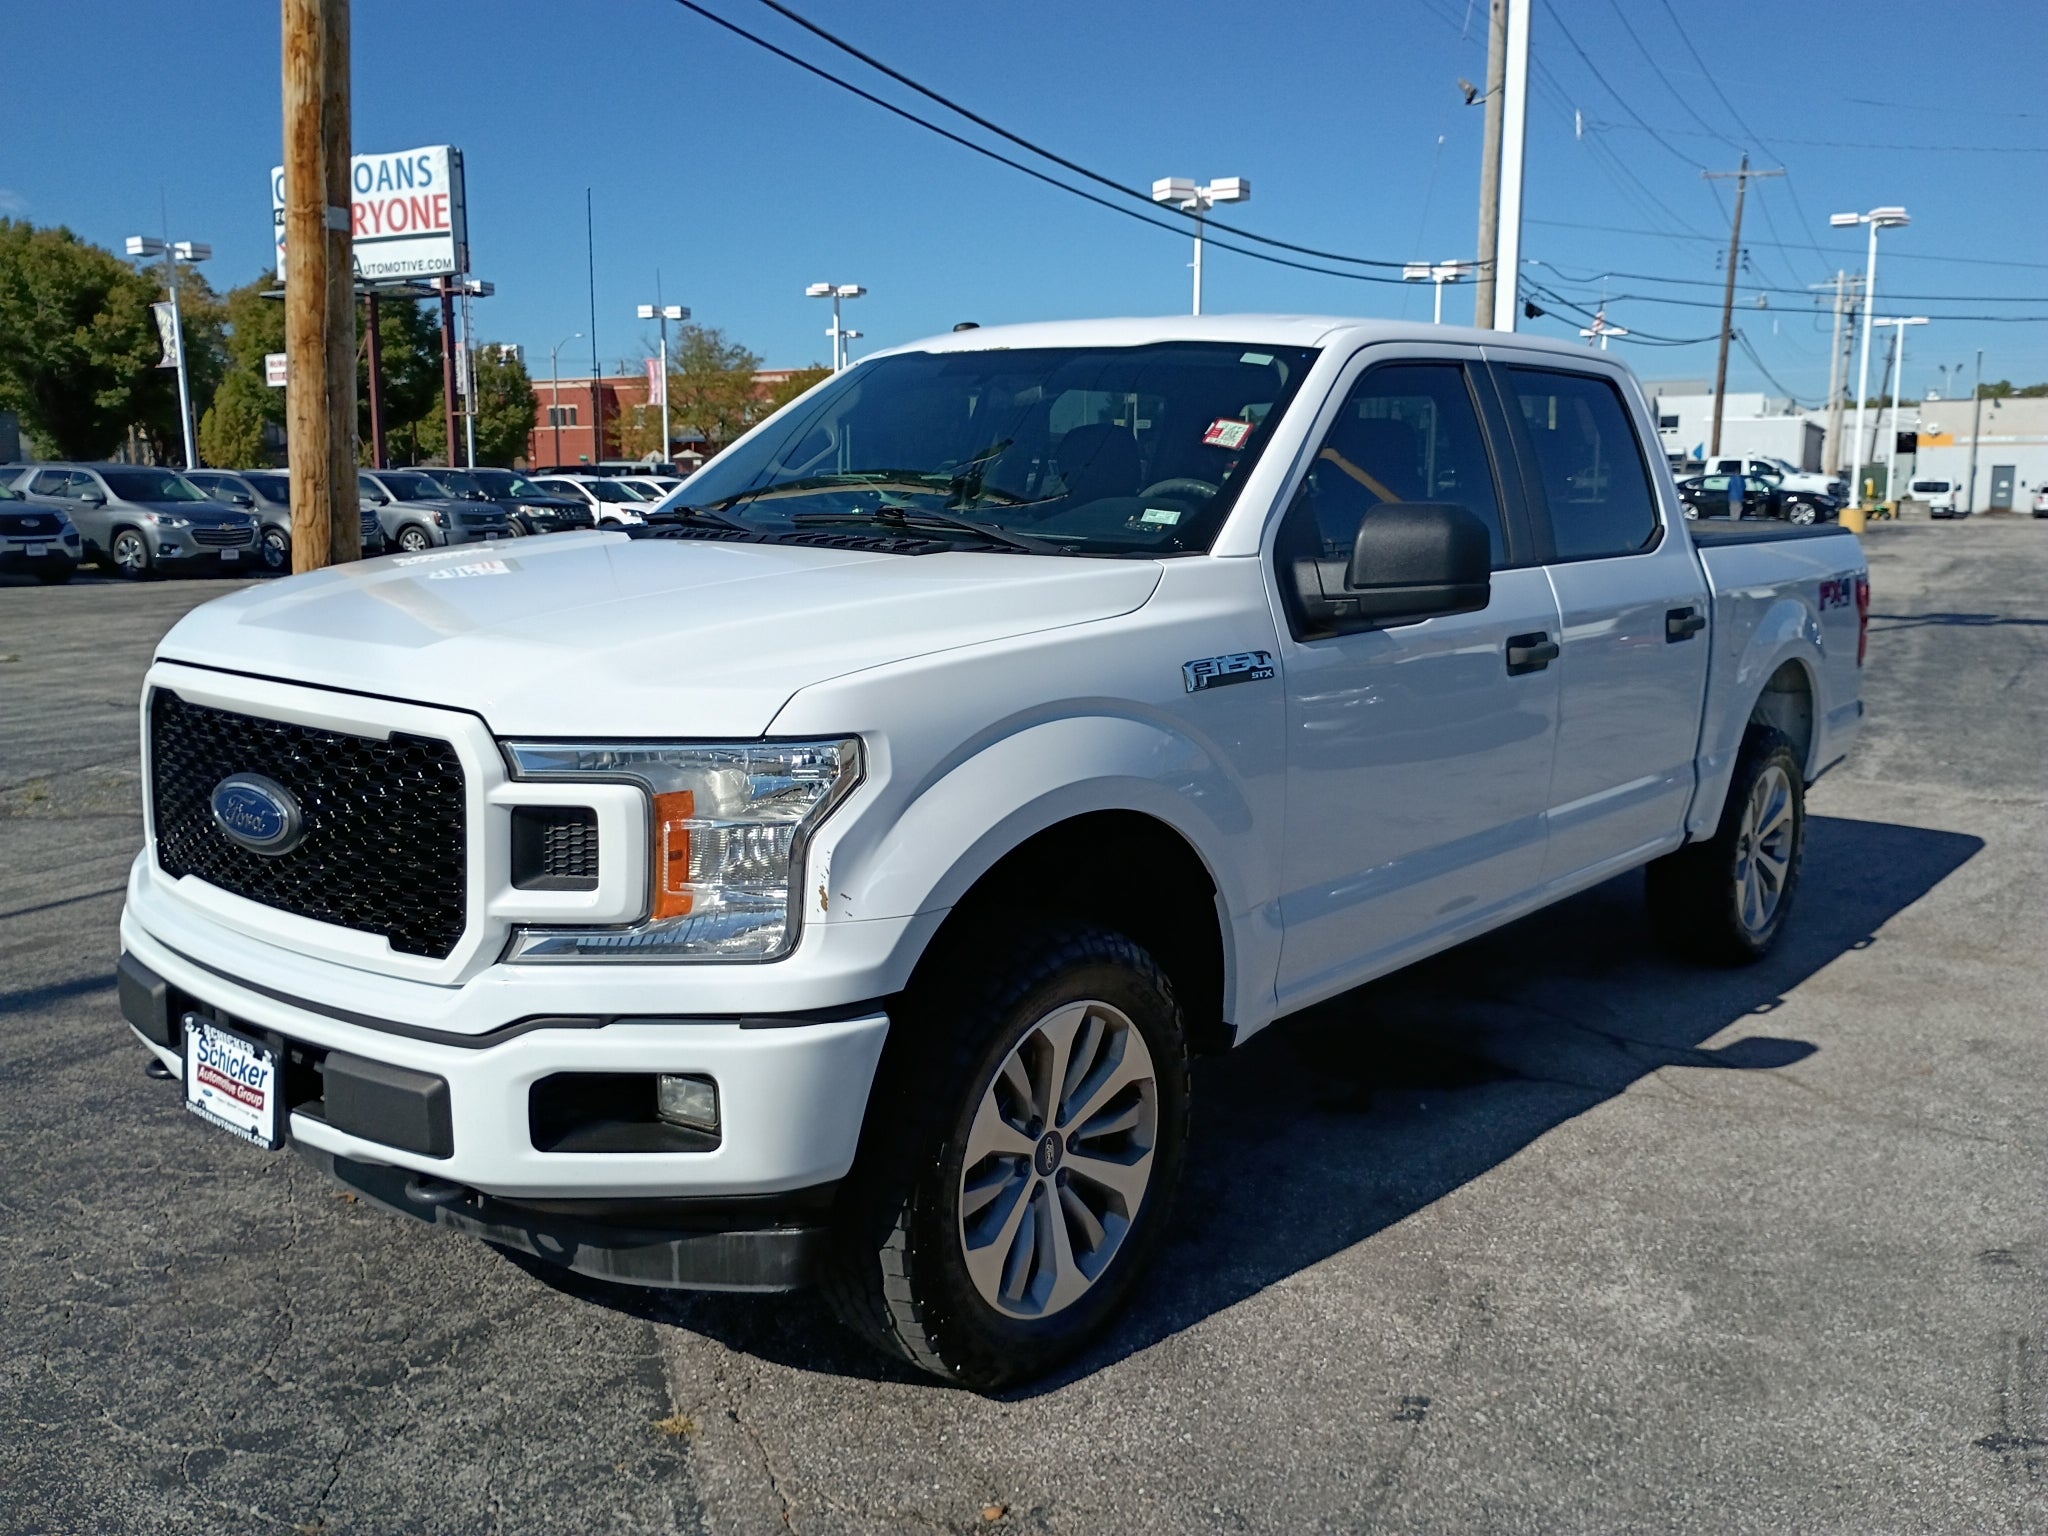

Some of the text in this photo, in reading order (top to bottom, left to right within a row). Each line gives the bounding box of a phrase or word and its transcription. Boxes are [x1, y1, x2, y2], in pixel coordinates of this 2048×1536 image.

[354, 155, 432, 194] OANS
[352, 194, 450, 236] RYONE
[352, 254, 452, 276] AUTOMOTIVE.COM
[197, 1036, 268, 1088] Schicker
[198, 1067, 263, 1107] Automotive Group
